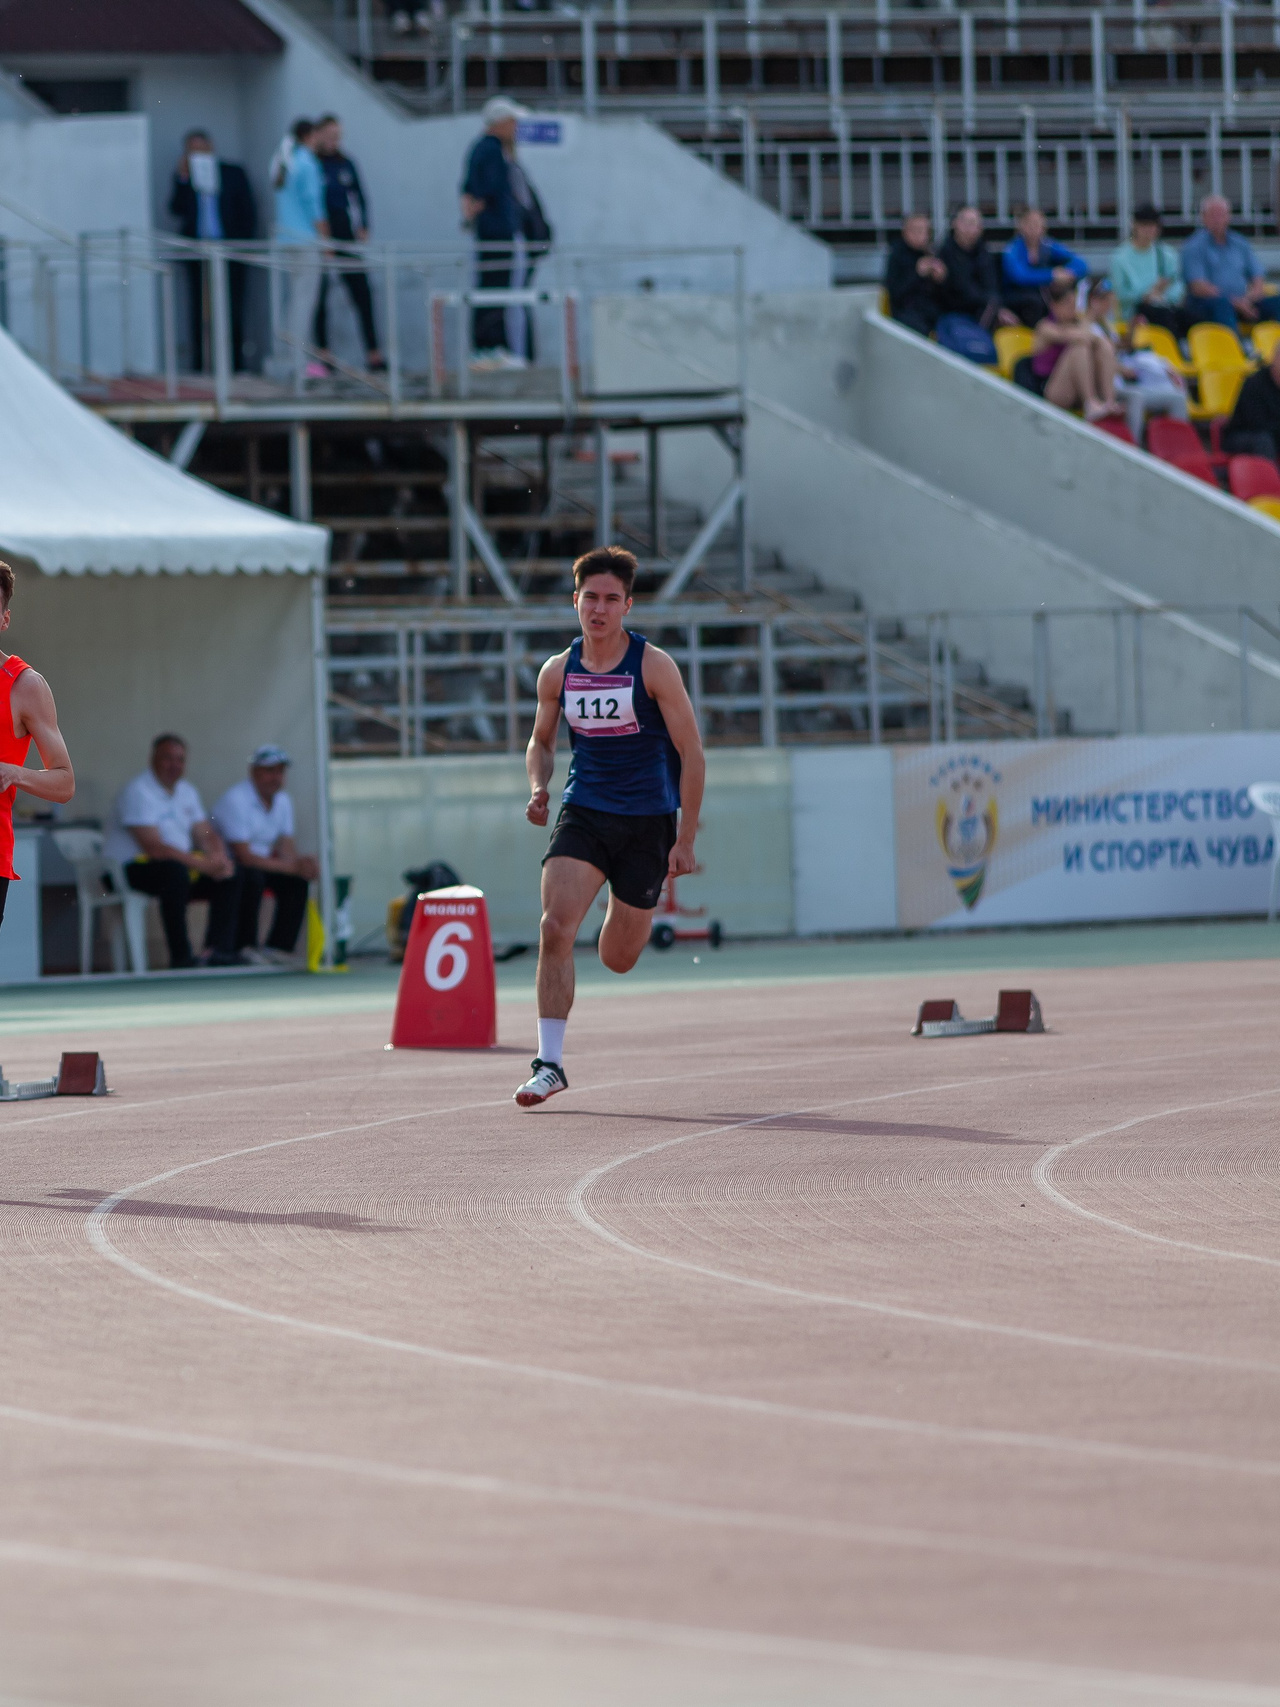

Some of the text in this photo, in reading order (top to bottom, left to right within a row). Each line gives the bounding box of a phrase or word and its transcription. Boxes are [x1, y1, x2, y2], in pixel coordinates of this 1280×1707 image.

[575, 697, 621, 720] 112
[1031, 787, 1255, 824] МИНИСТЕРСТВО
[1063, 839, 1082, 872] И
[1088, 837, 1202, 873] СПОРТА
[424, 904, 477, 916] MONDO
[424, 920, 474, 992] 6
